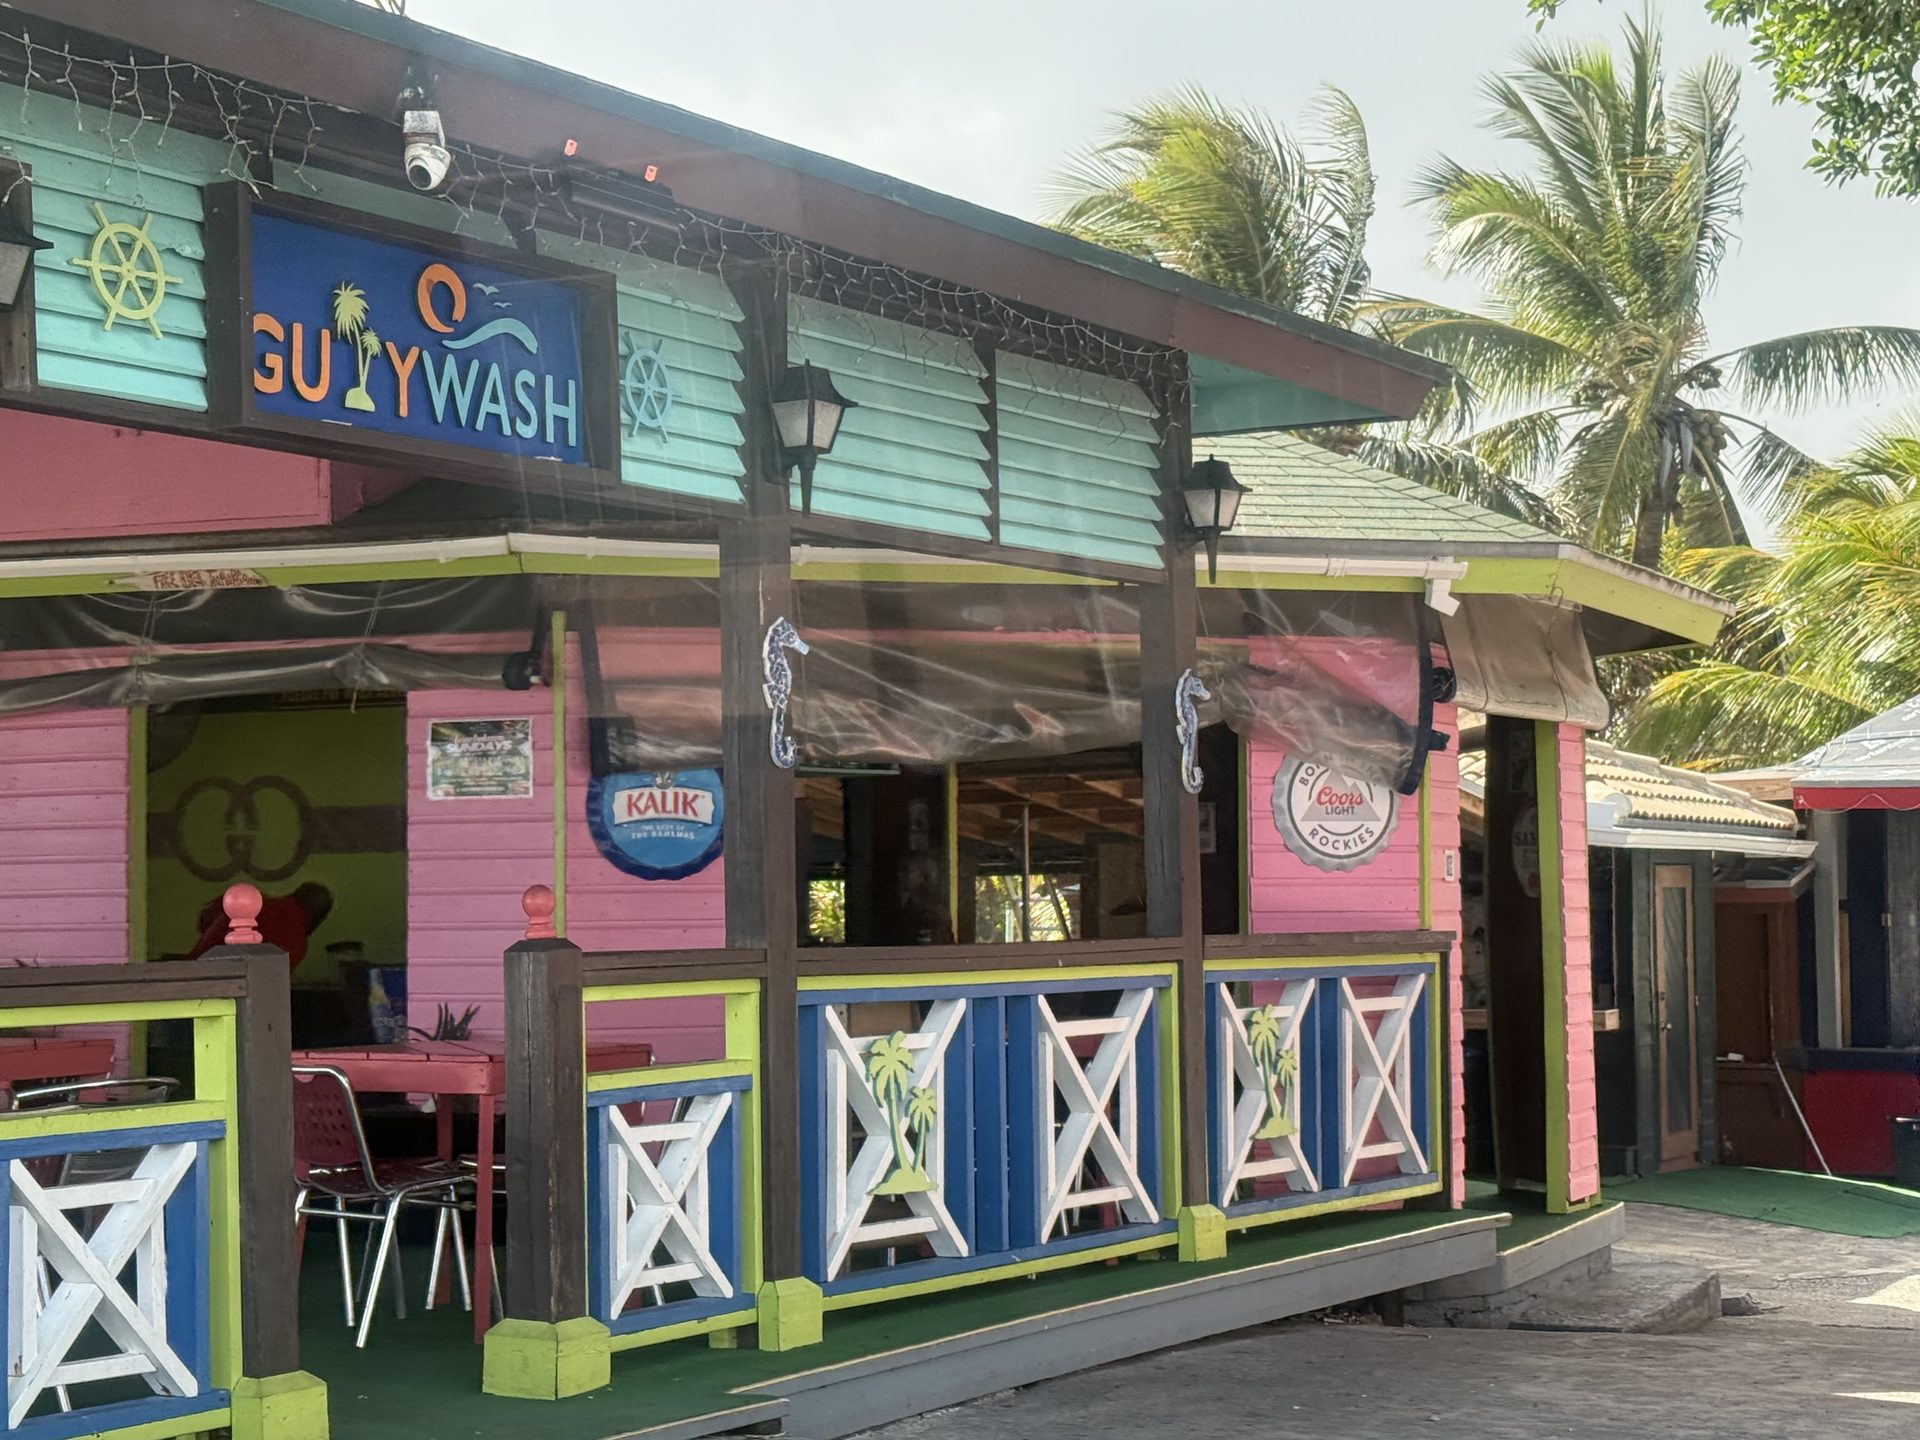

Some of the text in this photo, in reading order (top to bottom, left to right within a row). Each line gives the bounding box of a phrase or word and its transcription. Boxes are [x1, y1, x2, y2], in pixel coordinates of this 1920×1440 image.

[626, 791, 700, 817] KALIK
[1317, 786, 1364, 806] Coors
[1325, 806, 1356, 815] LIGHT
[651, 831, 695, 840] BAHAMAS
[1309, 827, 1375, 851] ROCKIES
